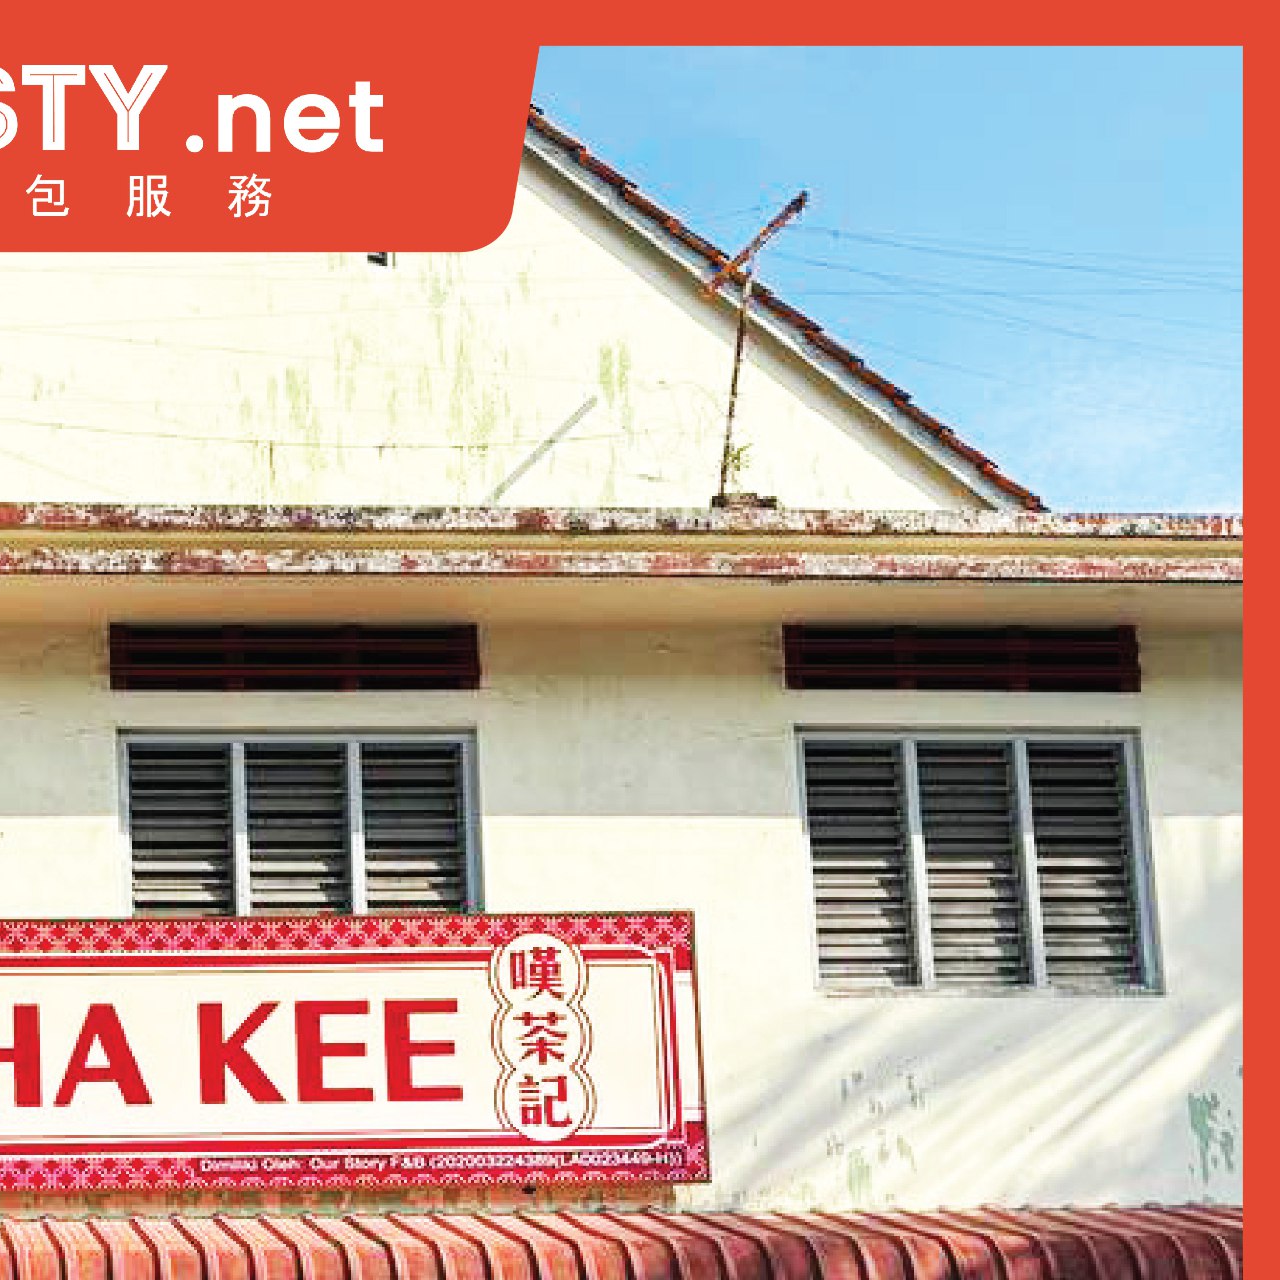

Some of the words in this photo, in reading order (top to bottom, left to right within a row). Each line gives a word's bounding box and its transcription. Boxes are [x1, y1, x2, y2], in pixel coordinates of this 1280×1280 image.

[197, 1000, 464, 1105] KEE
[509, 946, 573, 1127] 嘆茶記
